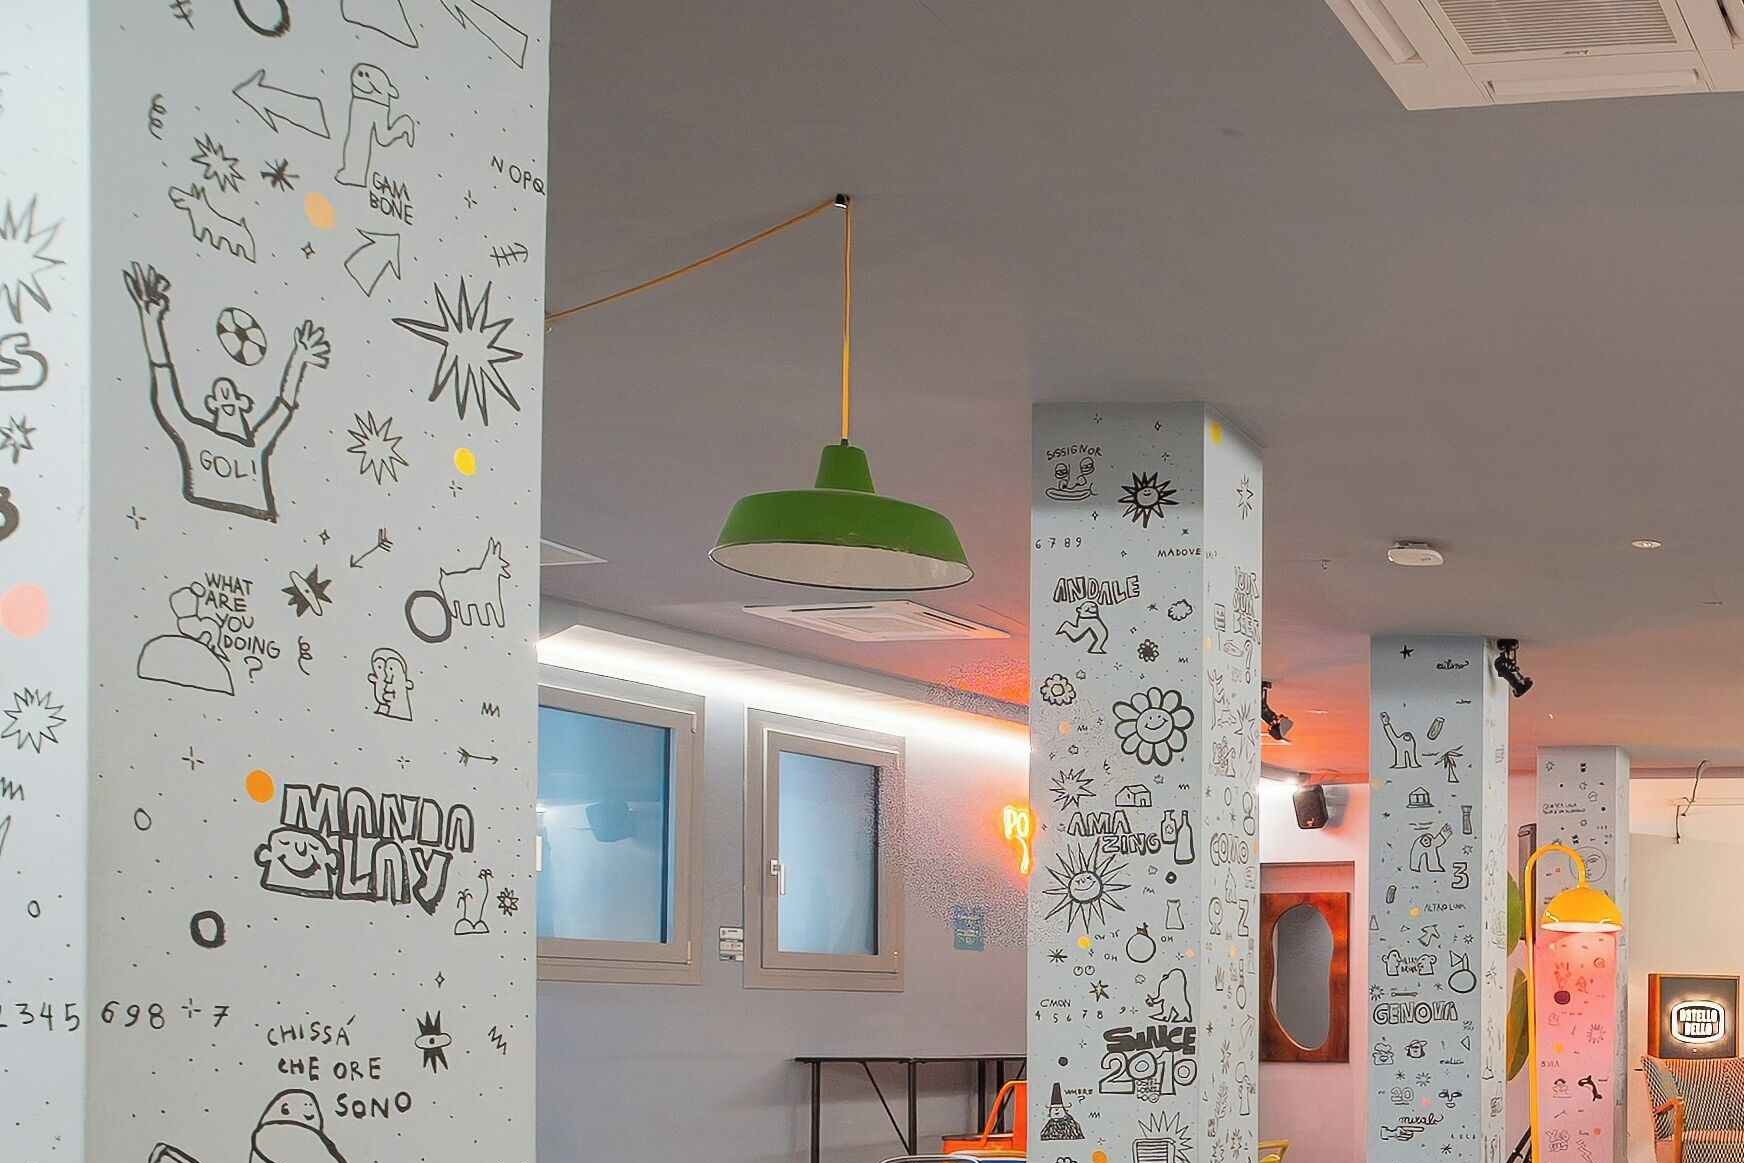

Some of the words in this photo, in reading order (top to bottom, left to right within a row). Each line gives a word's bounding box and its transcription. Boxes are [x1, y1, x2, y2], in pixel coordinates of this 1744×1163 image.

[372, 172, 410, 202] GAM
[369, 190, 414, 226] BONE
[199, 448, 257, 482] GOL!
[204, 571, 253, 596] WHAT
[1053, 575, 1141, 605] ANDALE
[204, 590, 248, 612] ARE
[215, 612, 254, 633] YOU
[223, 635, 280, 659] DOING
[1067, 809, 1131, 836] AMA
[1101, 832, 1162, 855] ZING
[1373, 1000, 1459, 1025] GENOVA
[1102, 1024, 1197, 1055] SINCE
[278, 1056, 320, 1081] CHE
[333, 1057, 381, 1081] ORE
[1099, 1050, 1198, 1096] 2010
[334, 1091, 412, 1119] SONO
